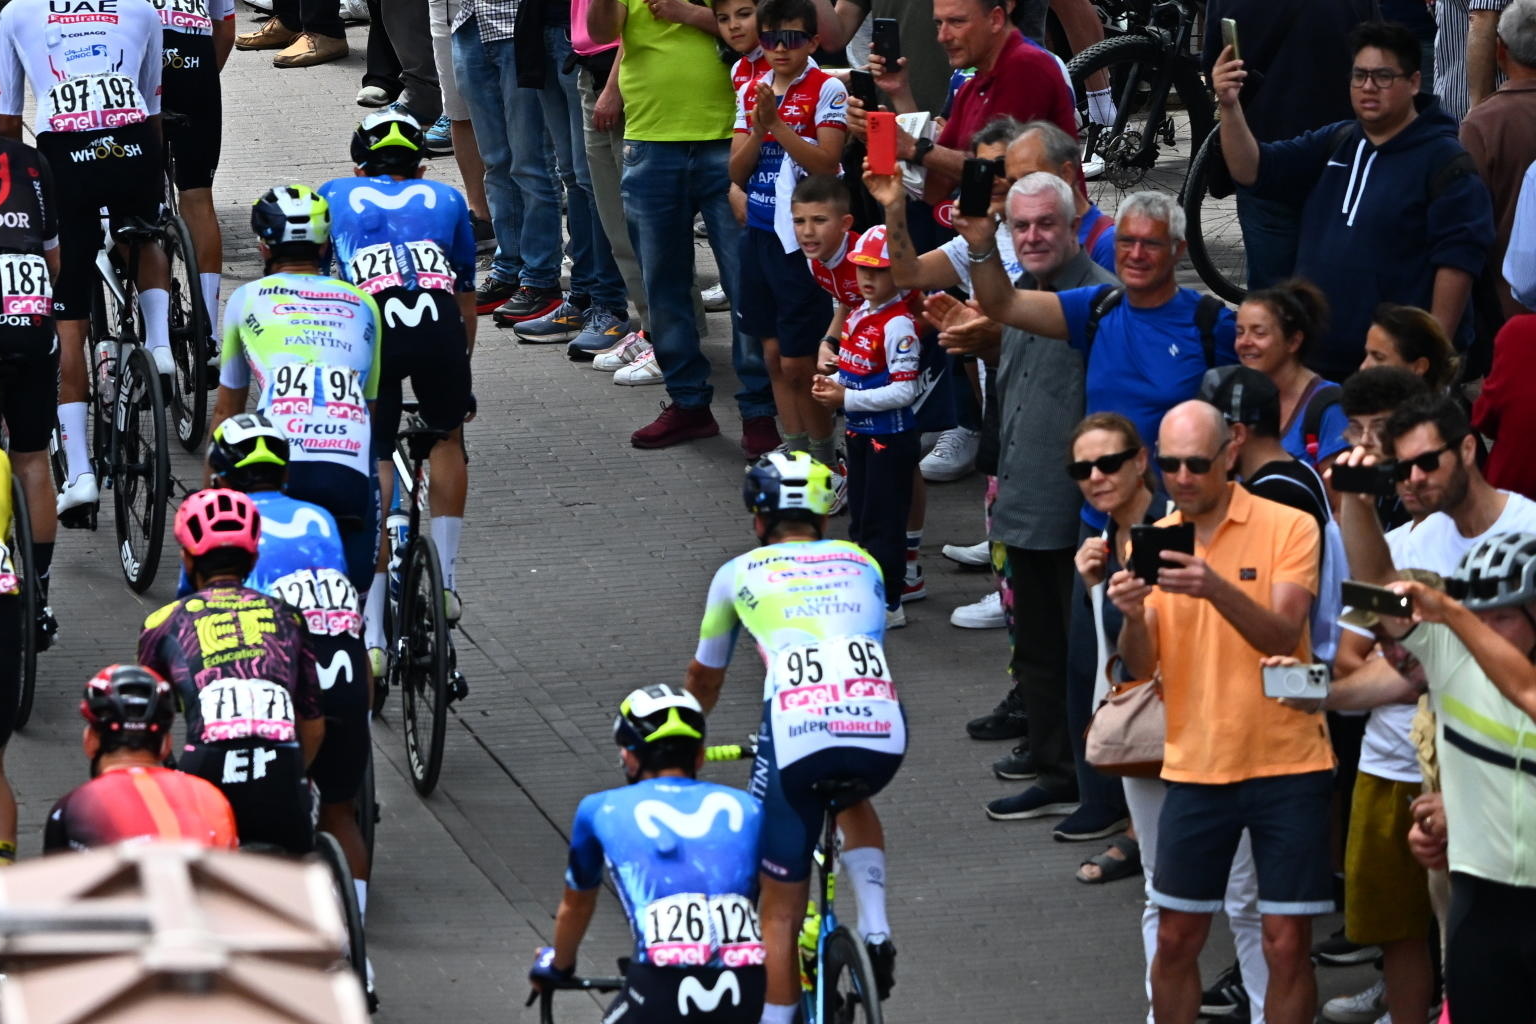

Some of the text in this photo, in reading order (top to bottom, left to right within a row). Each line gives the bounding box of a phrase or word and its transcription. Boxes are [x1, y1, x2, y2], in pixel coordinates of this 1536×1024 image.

[49, 0, 117, 14] UAE
[68, 30, 106, 38] COLNAGO
[50, 80, 90, 114] 197
[96, 78, 134, 108] 197
[54, 113, 97, 130] enel
[105, 110, 144, 124] enel
[355, 251, 392, 284] 127
[5, 261, 49, 296] 187
[10, 299, 52, 314] enel
[290, 319, 343, 327] GOBERT
[284, 335, 352, 352] FANTINI
[276, 366, 307, 397] 94
[330, 371, 359, 402] 94
[272, 399, 312, 415] enel
[328, 404, 364, 423] enel
[784, 603, 862, 617] FANTINI
[203, 648, 264, 668] Education
[787, 649, 823, 685] 95
[849, 642, 883, 677] 95
[214, 688, 241, 716] 71
[267, 690, 289, 716] 71
[781, 687, 838, 707] enel
[651, 903, 704, 943] 126
[653, 947, 710, 964] enel
